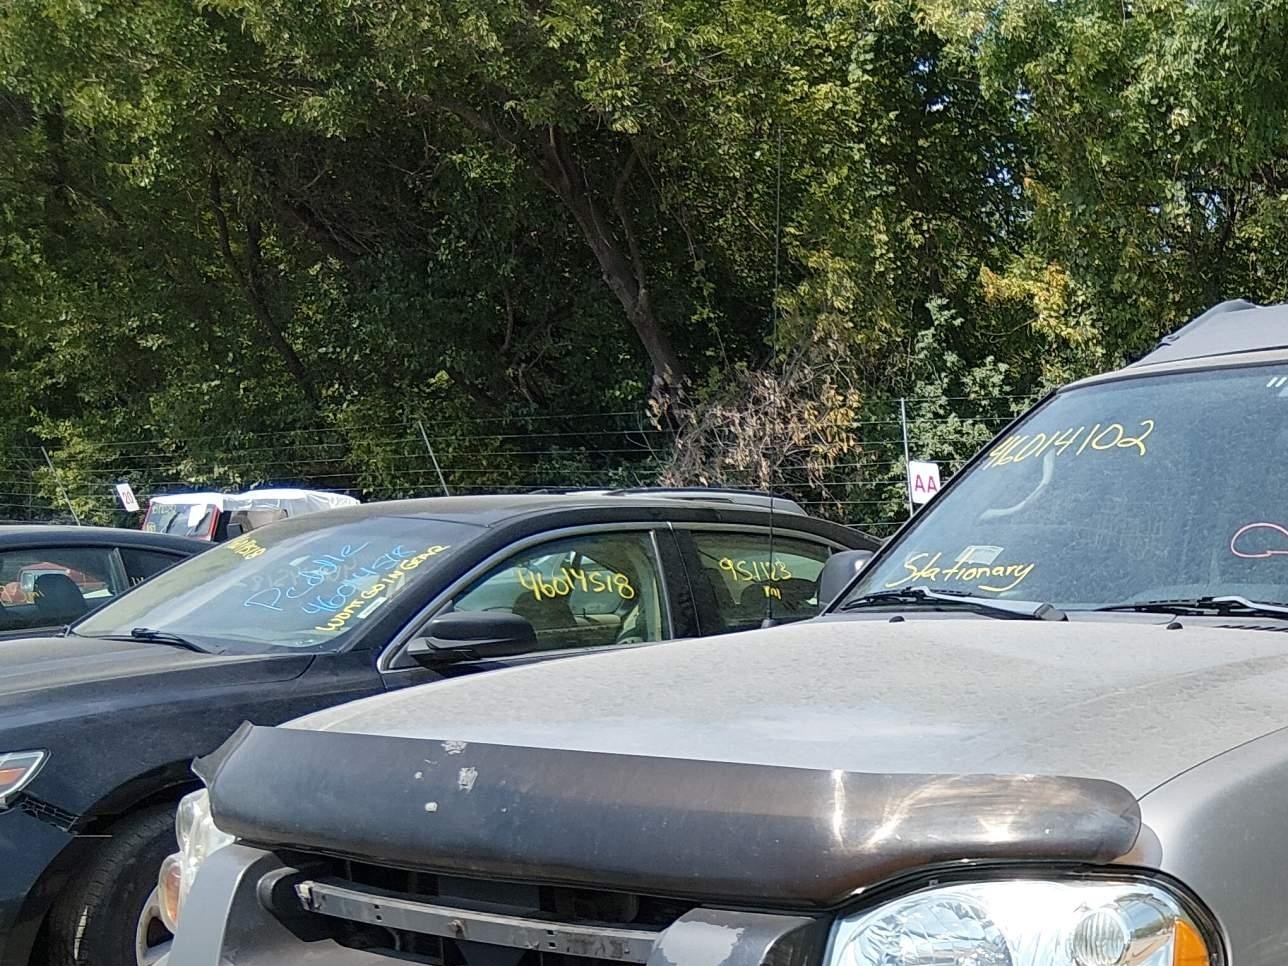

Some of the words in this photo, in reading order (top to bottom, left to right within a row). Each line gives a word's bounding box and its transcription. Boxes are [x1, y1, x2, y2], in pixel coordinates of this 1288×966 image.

[982, 420, 1154, 470] 46014102
[518, 568, 635, 601] 46014518
[885, 547, 1035, 592] Stationary
